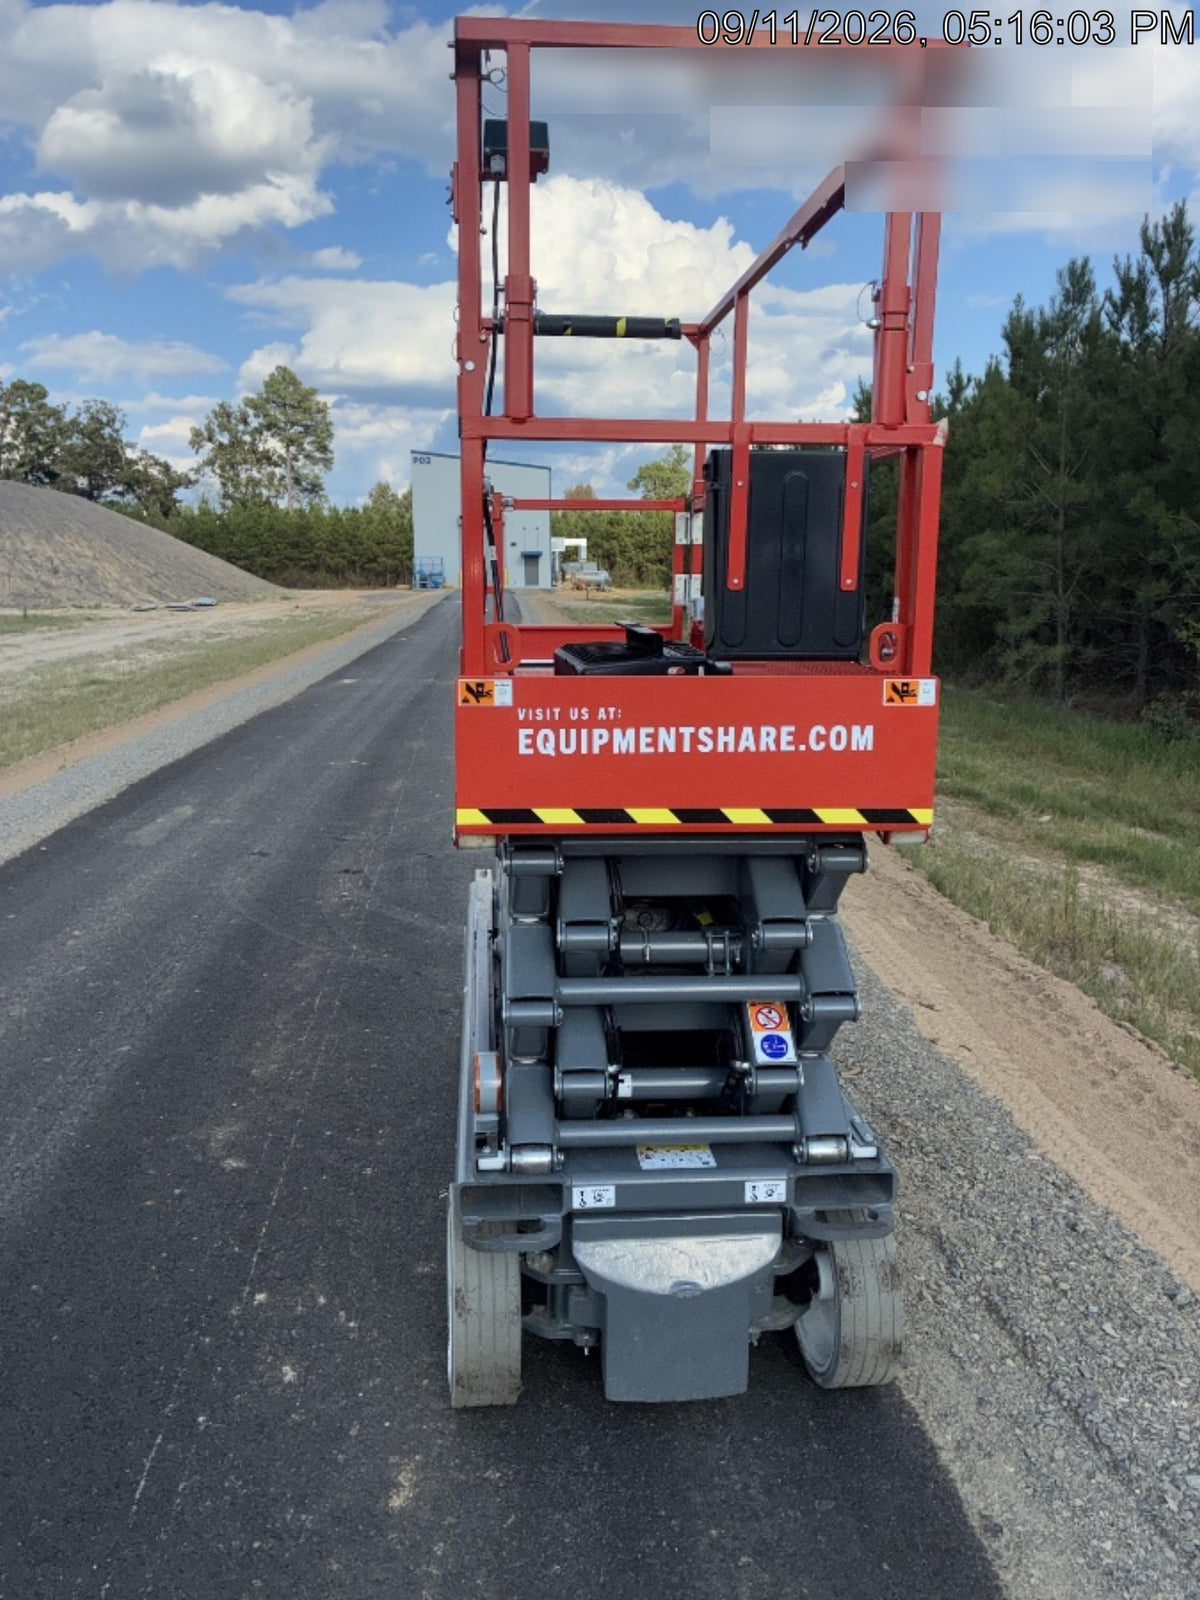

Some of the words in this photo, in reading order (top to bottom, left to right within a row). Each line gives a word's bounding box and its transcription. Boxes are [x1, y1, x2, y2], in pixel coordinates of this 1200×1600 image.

[517, 708, 561, 721] VISIT
[569, 707, 590, 720] US
[597, 707, 622, 720] AT:
[518, 725, 874, 756] EQUIPMENTSHARE.COM
